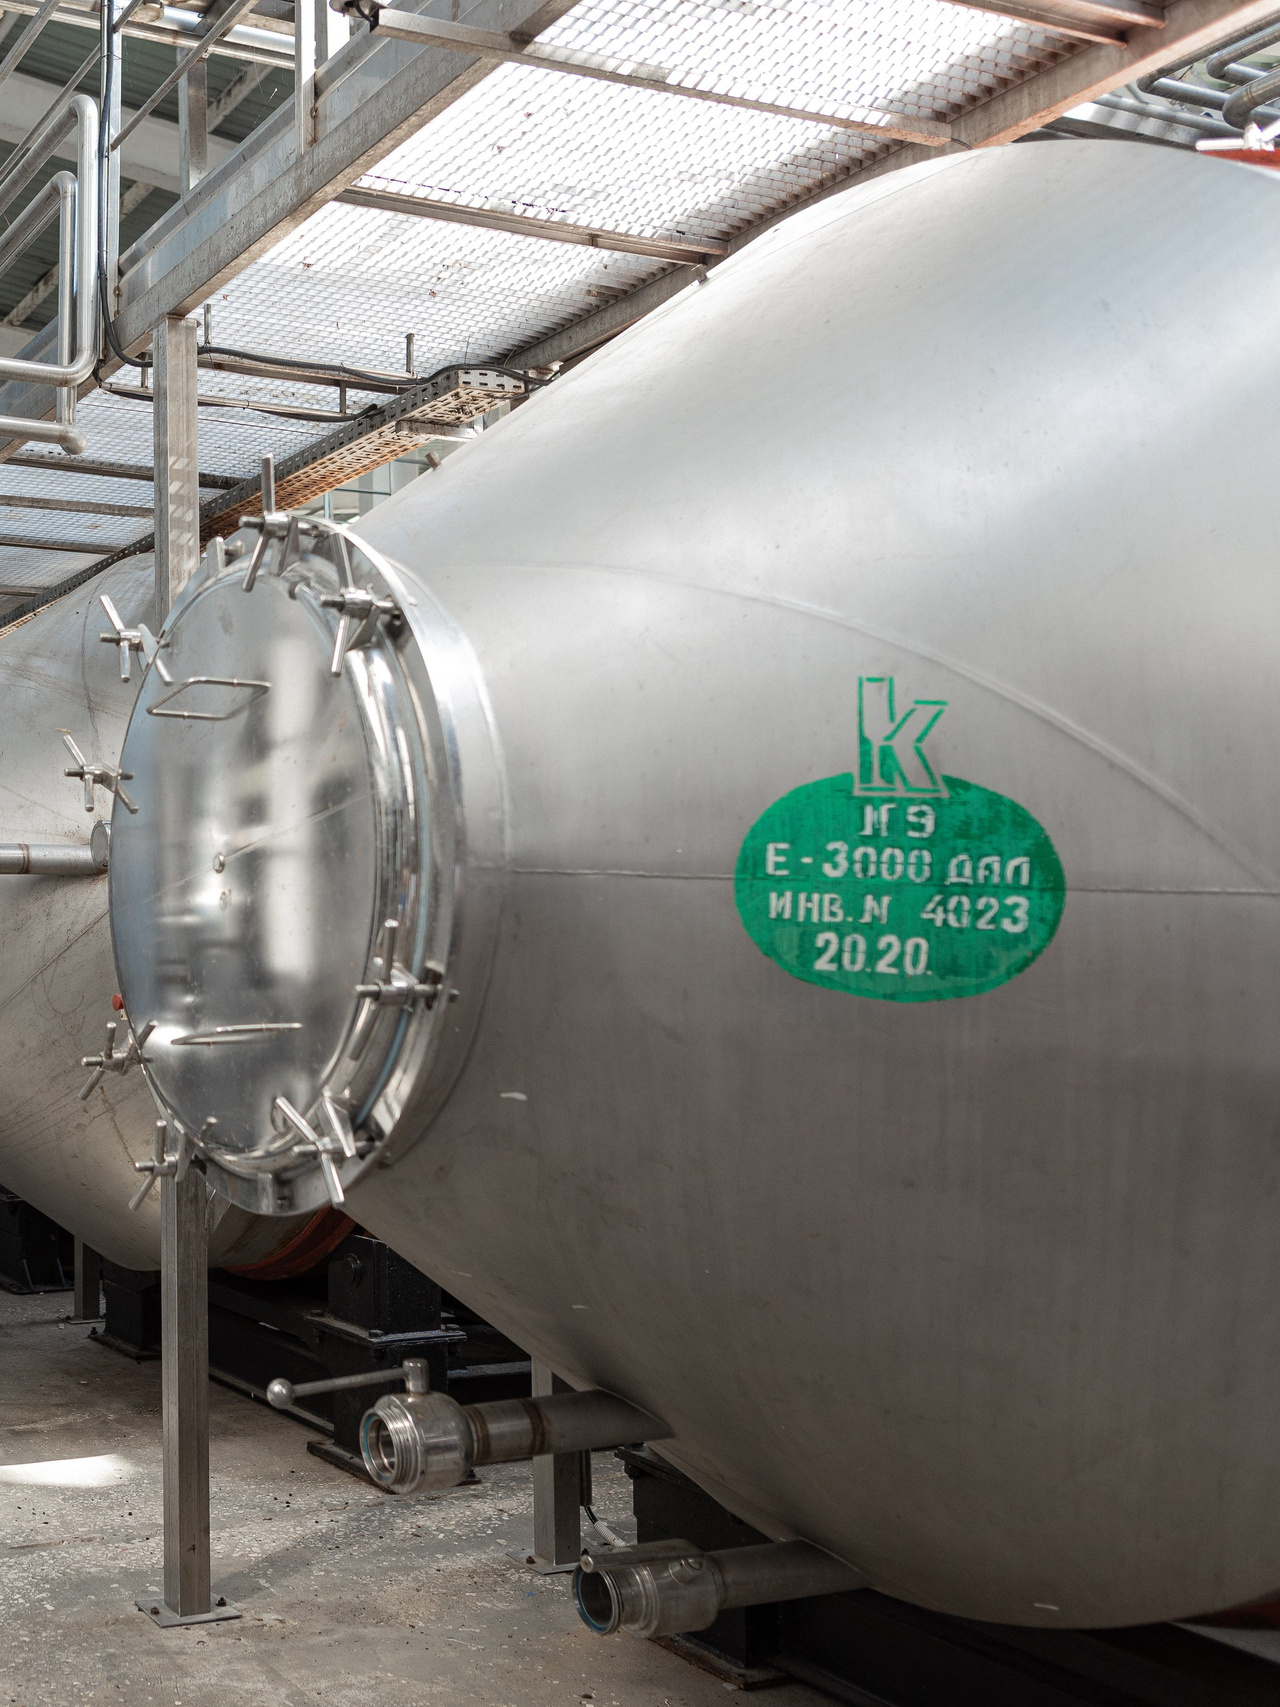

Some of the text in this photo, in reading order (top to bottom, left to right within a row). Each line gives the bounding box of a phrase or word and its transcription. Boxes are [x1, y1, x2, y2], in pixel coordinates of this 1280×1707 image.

[906, 804, 936, 838] 9
[822, 841, 932, 883] 3000
[920, 894, 1030, 934] 4023
